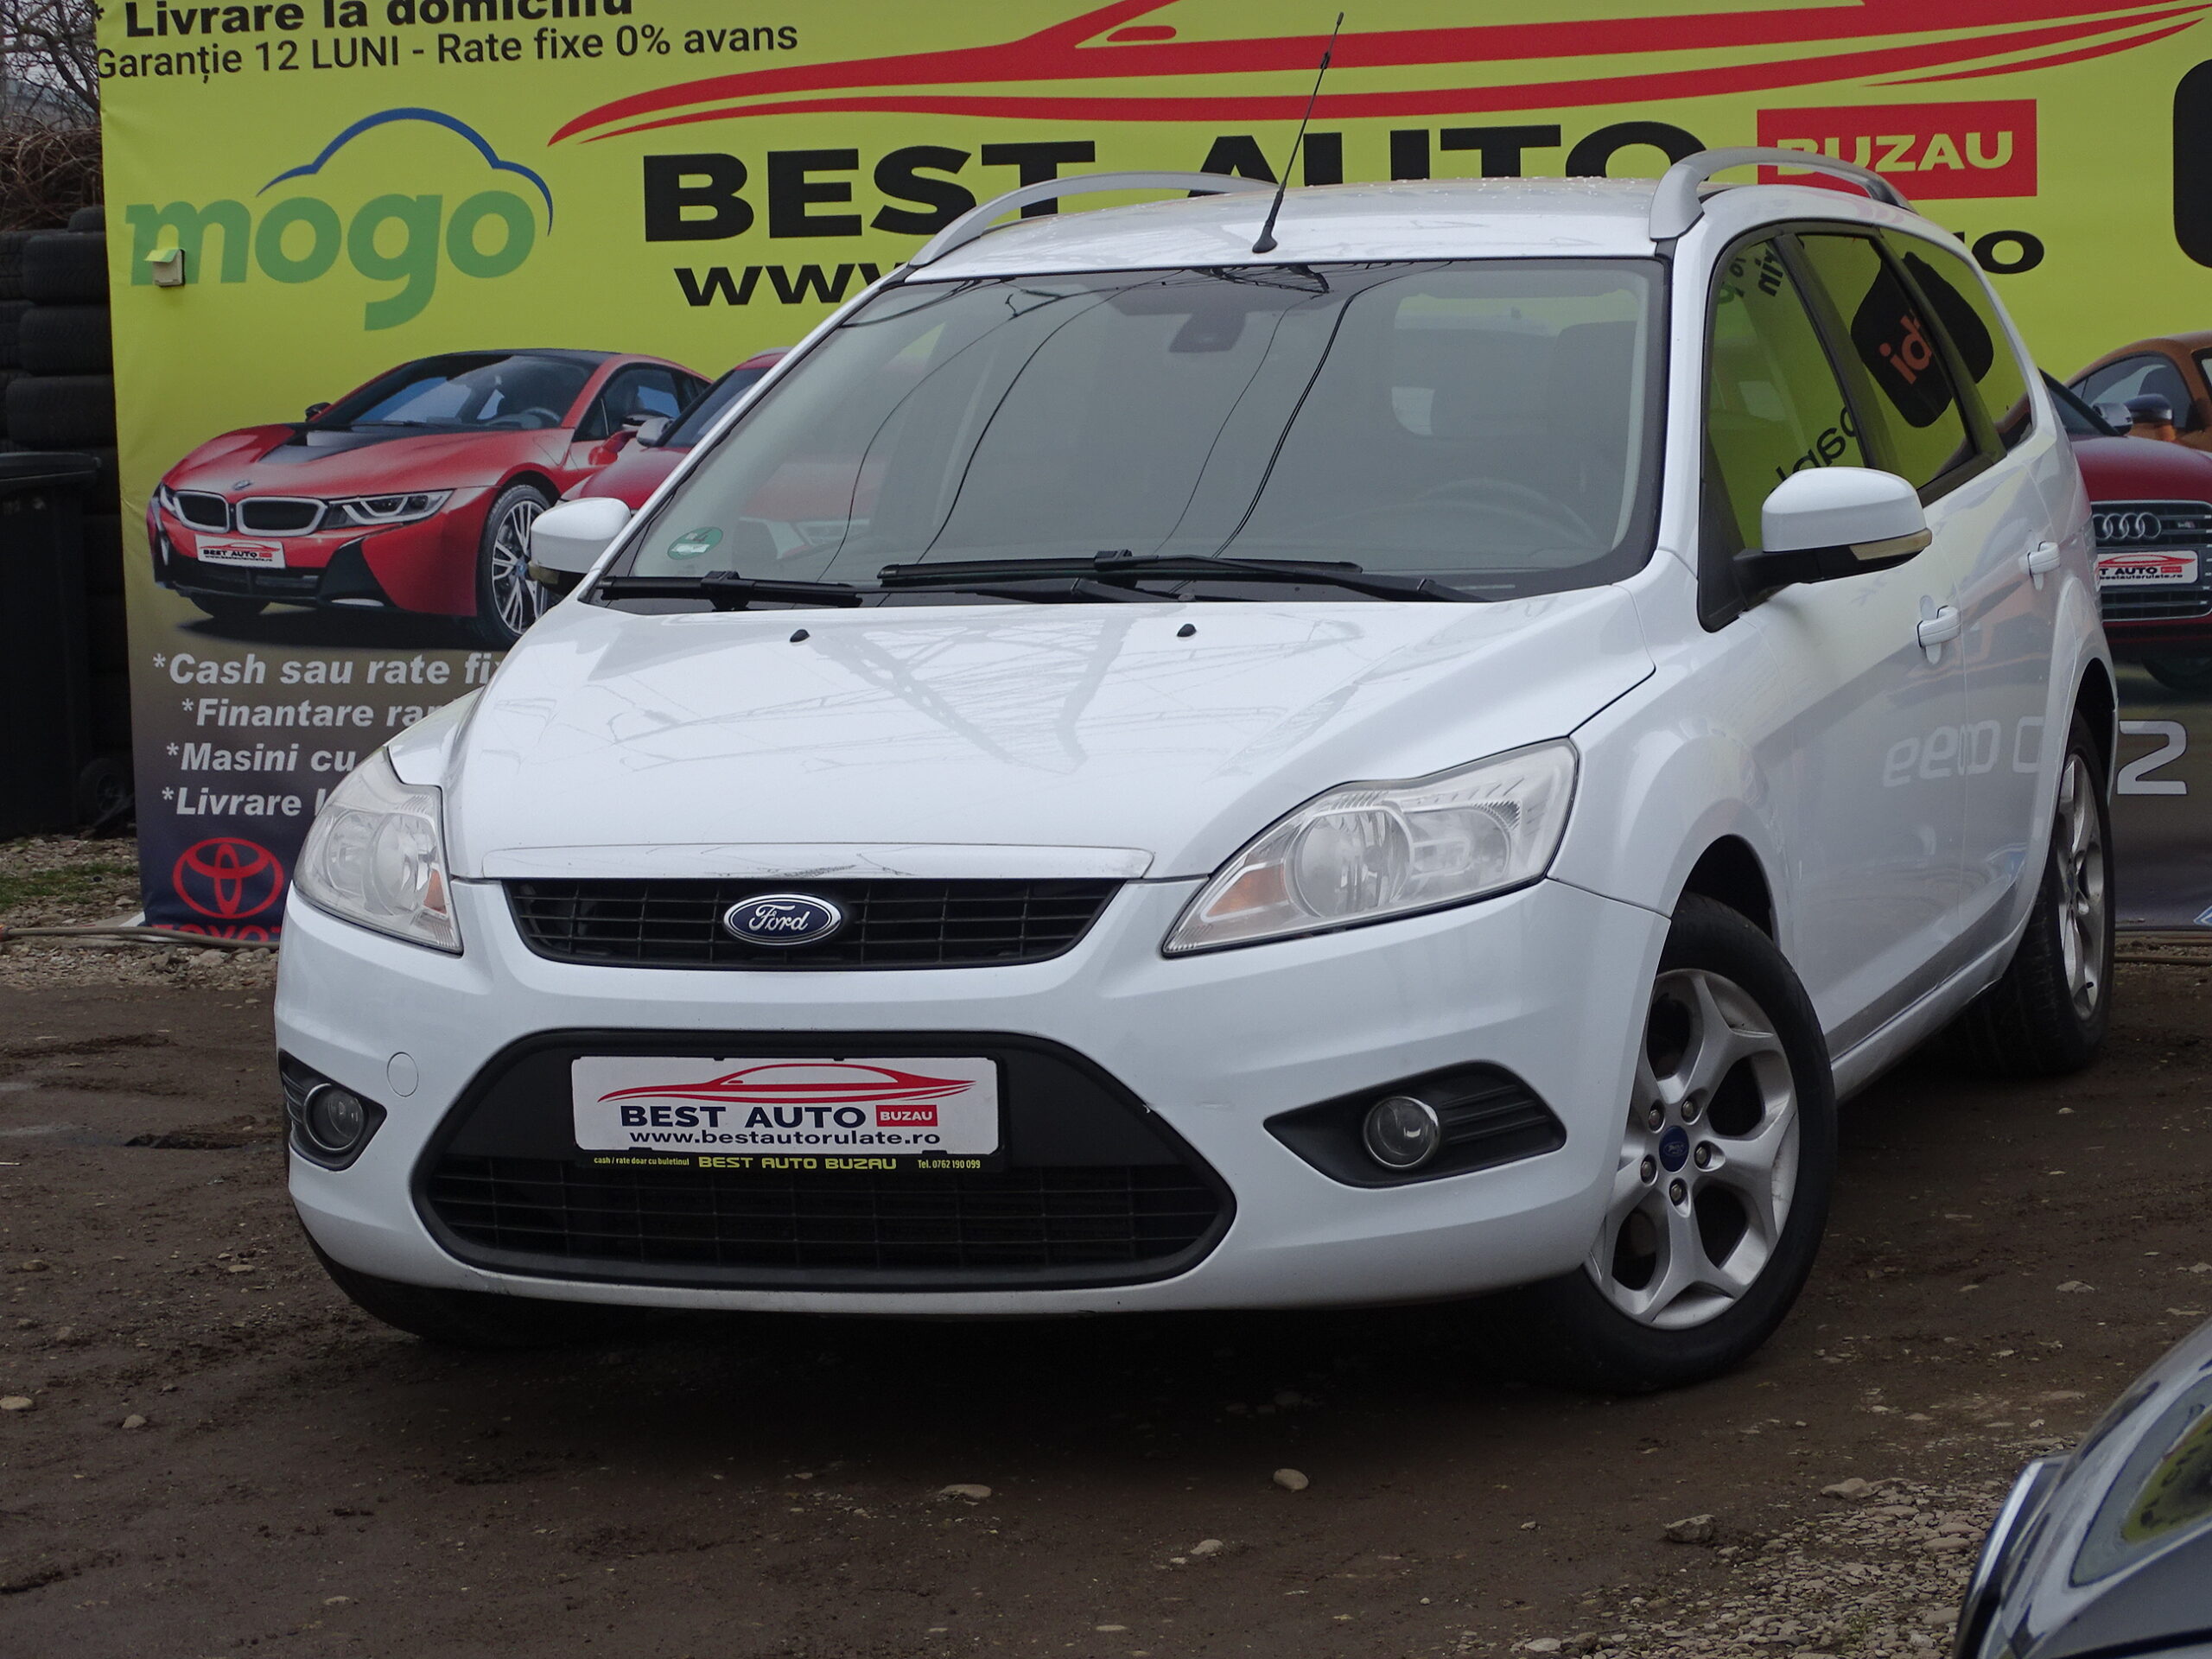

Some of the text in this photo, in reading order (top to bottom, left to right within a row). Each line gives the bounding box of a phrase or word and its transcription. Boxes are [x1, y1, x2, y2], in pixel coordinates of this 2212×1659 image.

[125, 0, 304, 37] Livrare
[323, 0, 368, 29] la
[97, 43, 242, 83] Garanție
[255, 40, 299, 72] 12
[312, 35, 399, 69] LUNI
[438, 33, 522, 63] Rate
[534, 27, 603, 59] fixe
[616, 24, 671, 56] 0%
[683, 25, 798, 54] avans
[644, 141, 1095, 242] BEST
[125, 190, 537, 331] mogo
[2114, 567, 2158, 575] AUTO
[279, 660, 353, 684] sau
[366, 654, 450, 684] rate
[465, 652, 502, 684] fi
[386, 705, 443, 727] ra
[310, 750, 356, 772] cu
[2117, 719, 2188, 795] 2
[748, 904, 810, 931] Ford
[620, 1105, 933, 1128] BEST AUTO BUZAU
[629, 1130, 941, 1145] www.bestautorulate.ro
[698, 1156, 753, 1168] BEST
[761, 1157, 817, 1169] AUTO
[825, 1158, 897, 1169] BUZAU
[918, 1160, 931, 1168] Tel.
[932, 1160, 950, 1169] 0762
[952, 1160, 964, 1169] 190
[966, 1160, 981, 1169] 099
